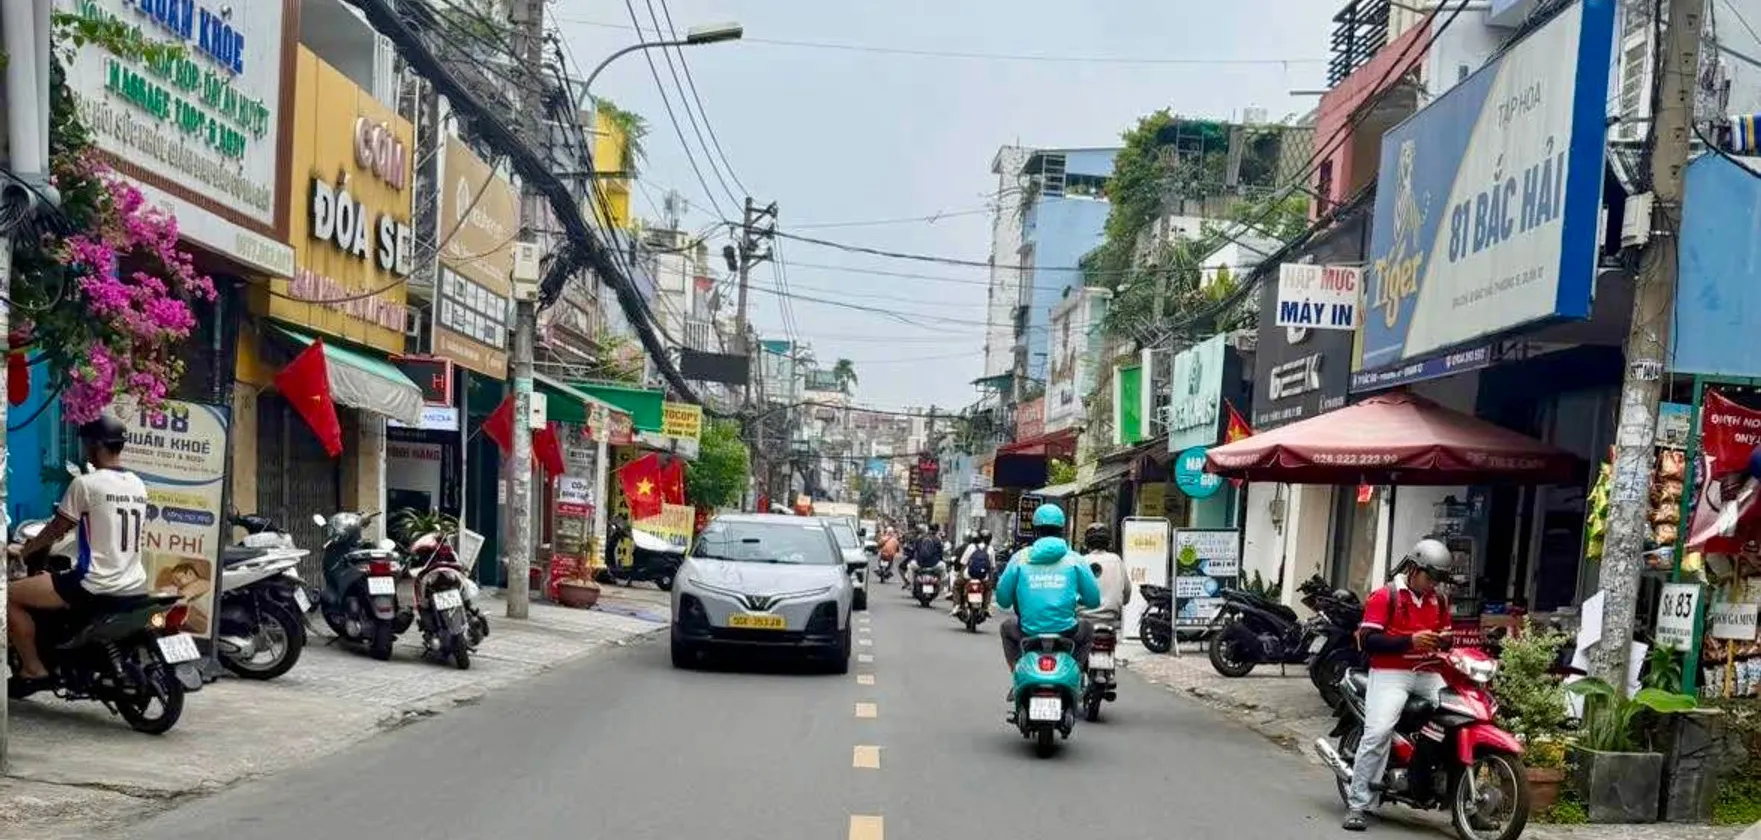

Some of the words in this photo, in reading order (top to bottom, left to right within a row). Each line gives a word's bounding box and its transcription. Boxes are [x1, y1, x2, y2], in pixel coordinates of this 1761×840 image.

[107, 58, 170, 120] MASSAGE
[1449, 200, 1471, 263] 81
[1473, 153, 1516, 253] BẮC
[1520, 135, 1565, 233] HẢI
[1321, 268, 1355, 296] MỰC
[1372, 250, 1423, 327] Tiger
[1281, 297, 1325, 325] MÁY
[1331, 304, 1353, 326] IN
[117, 507, 140, 552] 11
[169, 533, 205, 553] PHÍ
[1676, 593, 1693, 618] 83
